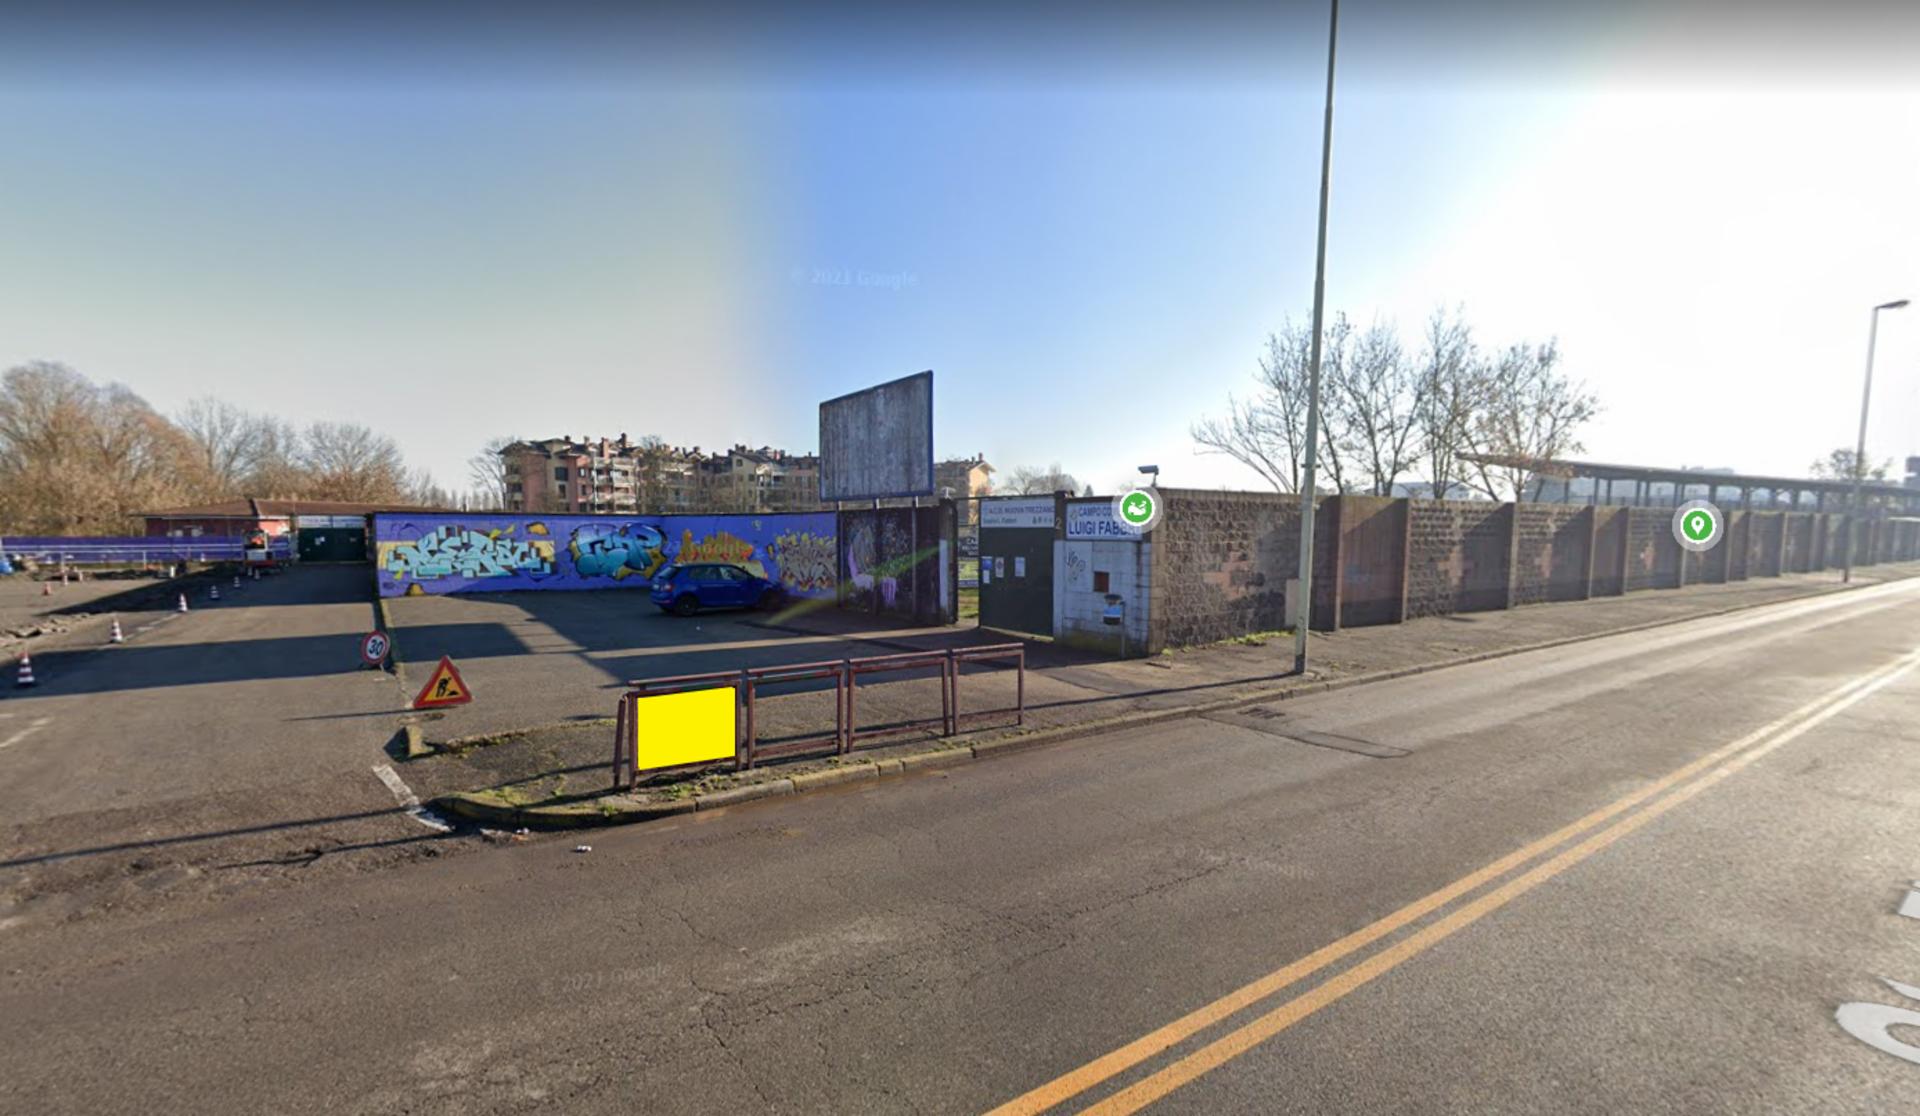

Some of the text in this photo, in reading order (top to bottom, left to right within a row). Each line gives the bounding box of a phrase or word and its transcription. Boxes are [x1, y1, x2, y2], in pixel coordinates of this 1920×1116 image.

[1079, 506, 1101, 517] CAMPO
[1068, 520, 1096, 536] LUIGI
[368, 639, 384, 656] 30
